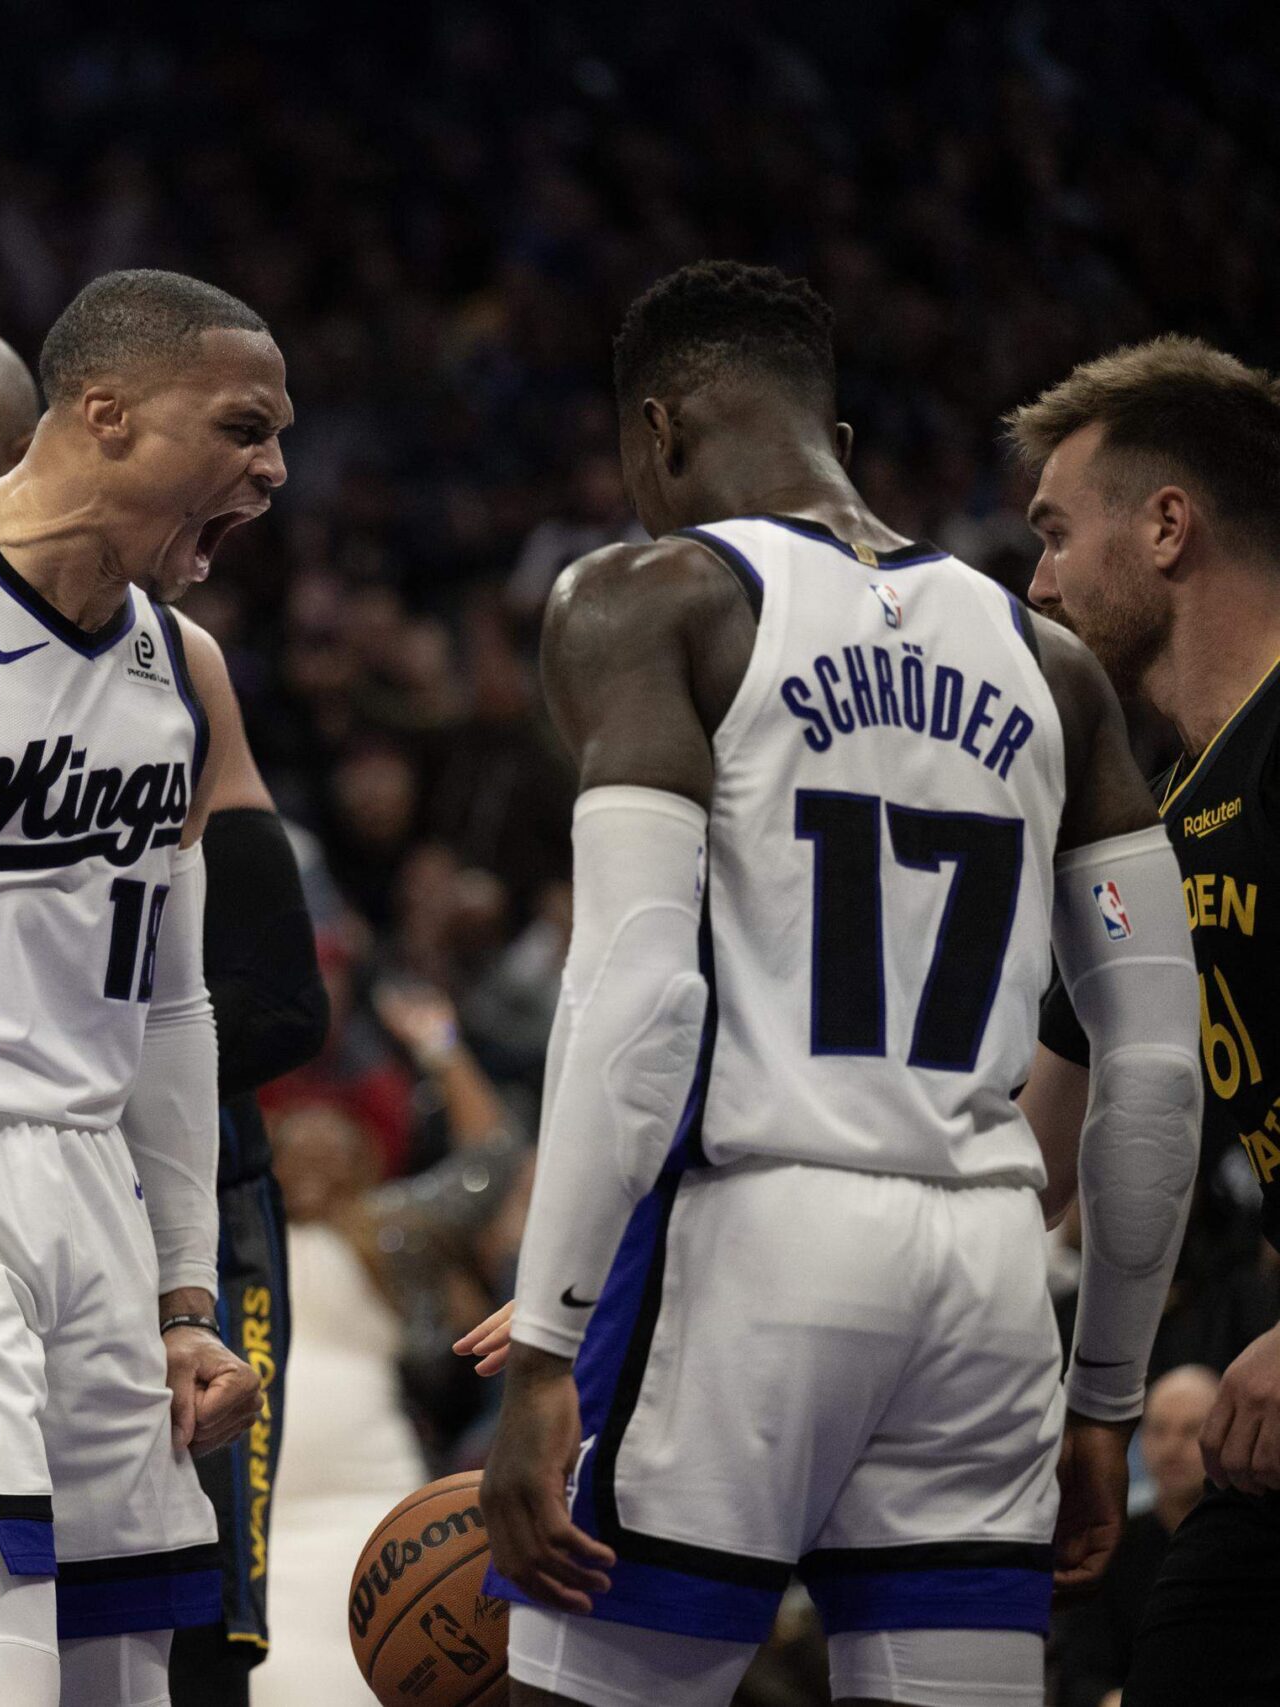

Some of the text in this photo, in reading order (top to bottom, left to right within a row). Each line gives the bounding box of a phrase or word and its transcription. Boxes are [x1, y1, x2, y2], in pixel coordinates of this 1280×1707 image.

[781, 643, 1035, 781] SCHRÖDER
[1183, 797, 1242, 838] Rakuten
[795, 788, 1024, 1073] 17
[1183, 873, 1258, 937] DEN
[1199, 964, 1263, 1100] 61
[350, 1505, 486, 1639] Wilson
